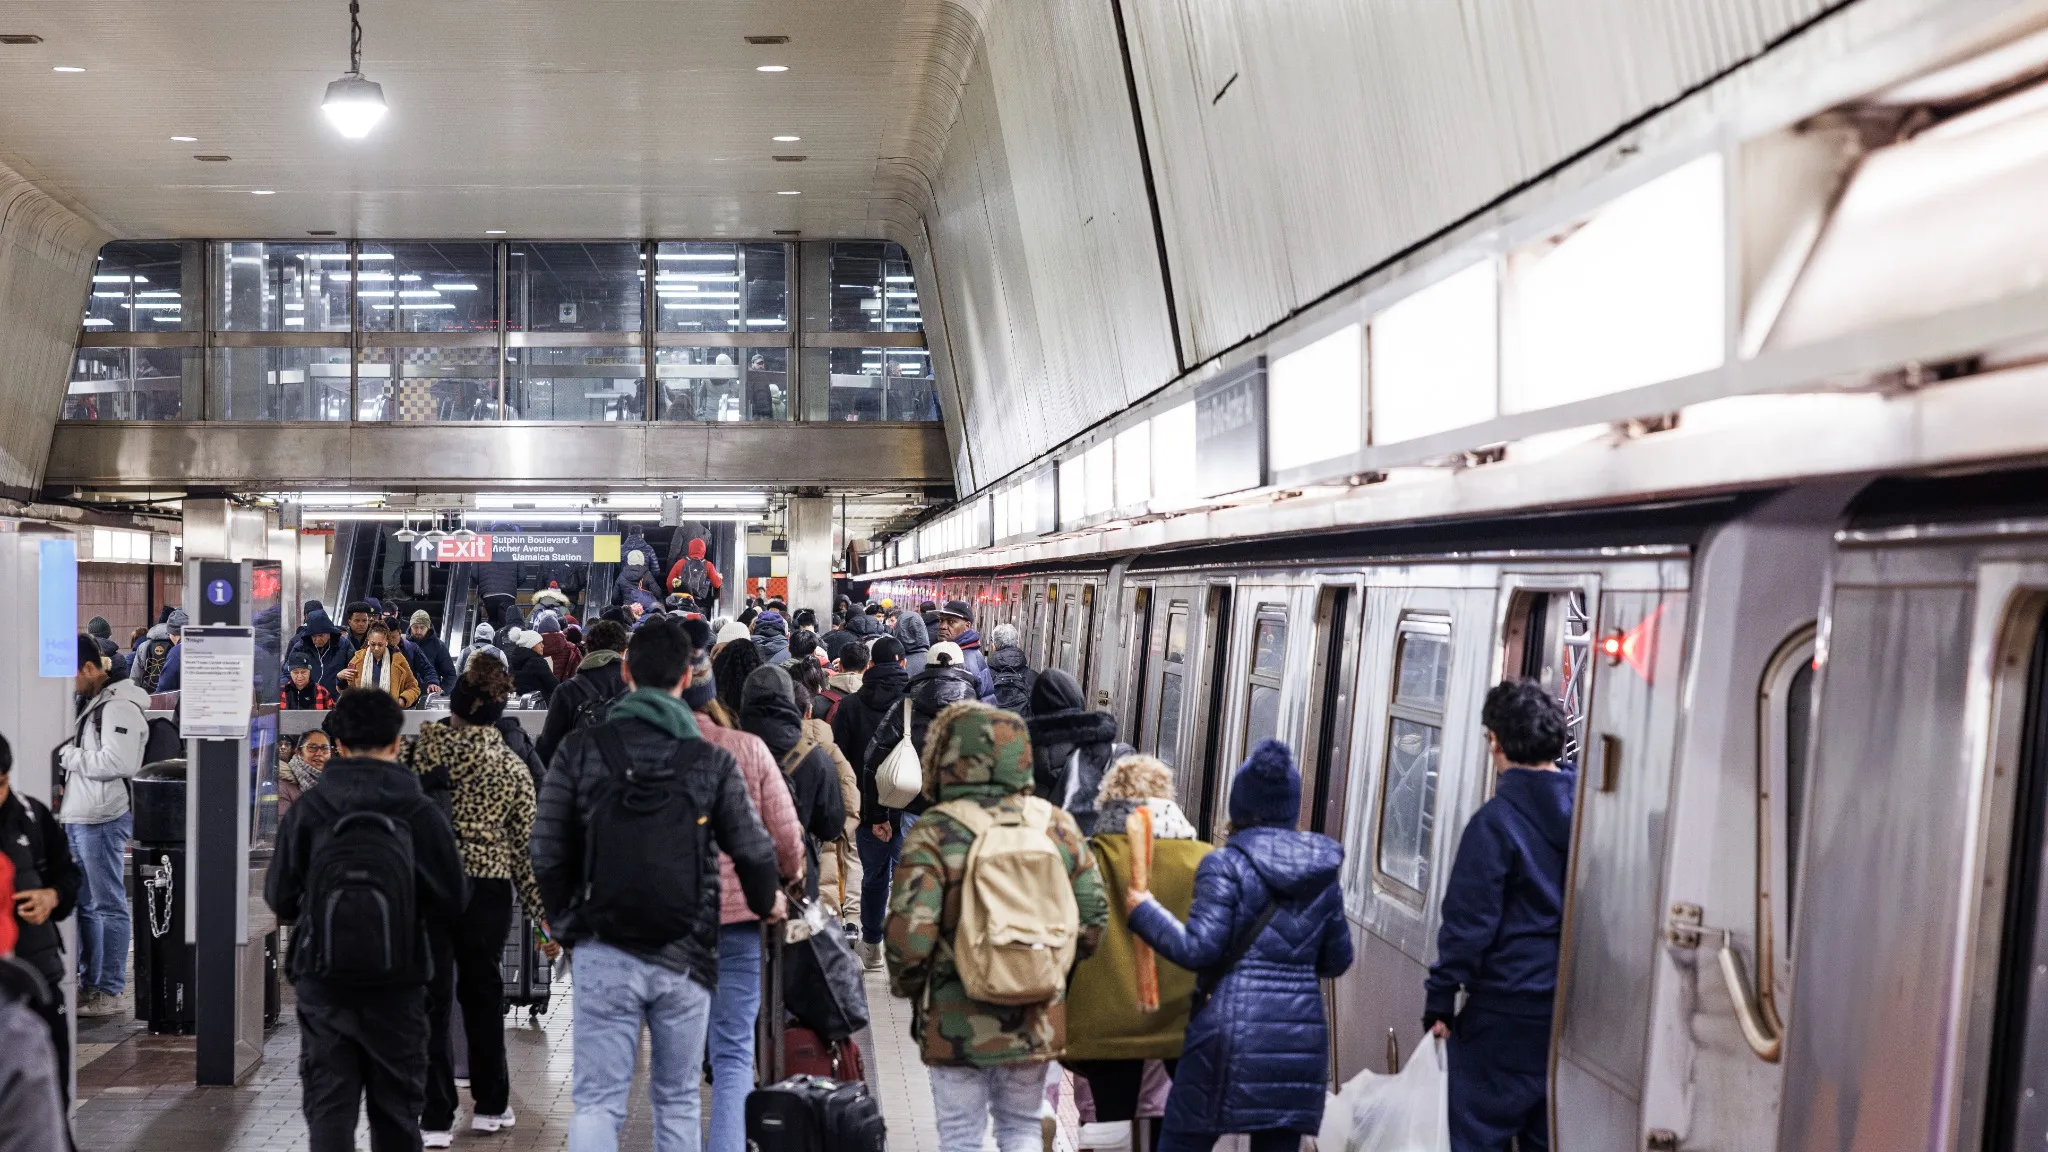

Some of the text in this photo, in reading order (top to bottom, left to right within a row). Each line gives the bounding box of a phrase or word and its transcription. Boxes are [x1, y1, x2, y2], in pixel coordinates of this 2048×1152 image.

[492, 536, 579, 546] Sutphin Boulevard &
[439, 535, 486, 558] Exit
[492, 545, 555, 553] Archer Avenue
[552, 553, 582, 561] Station
